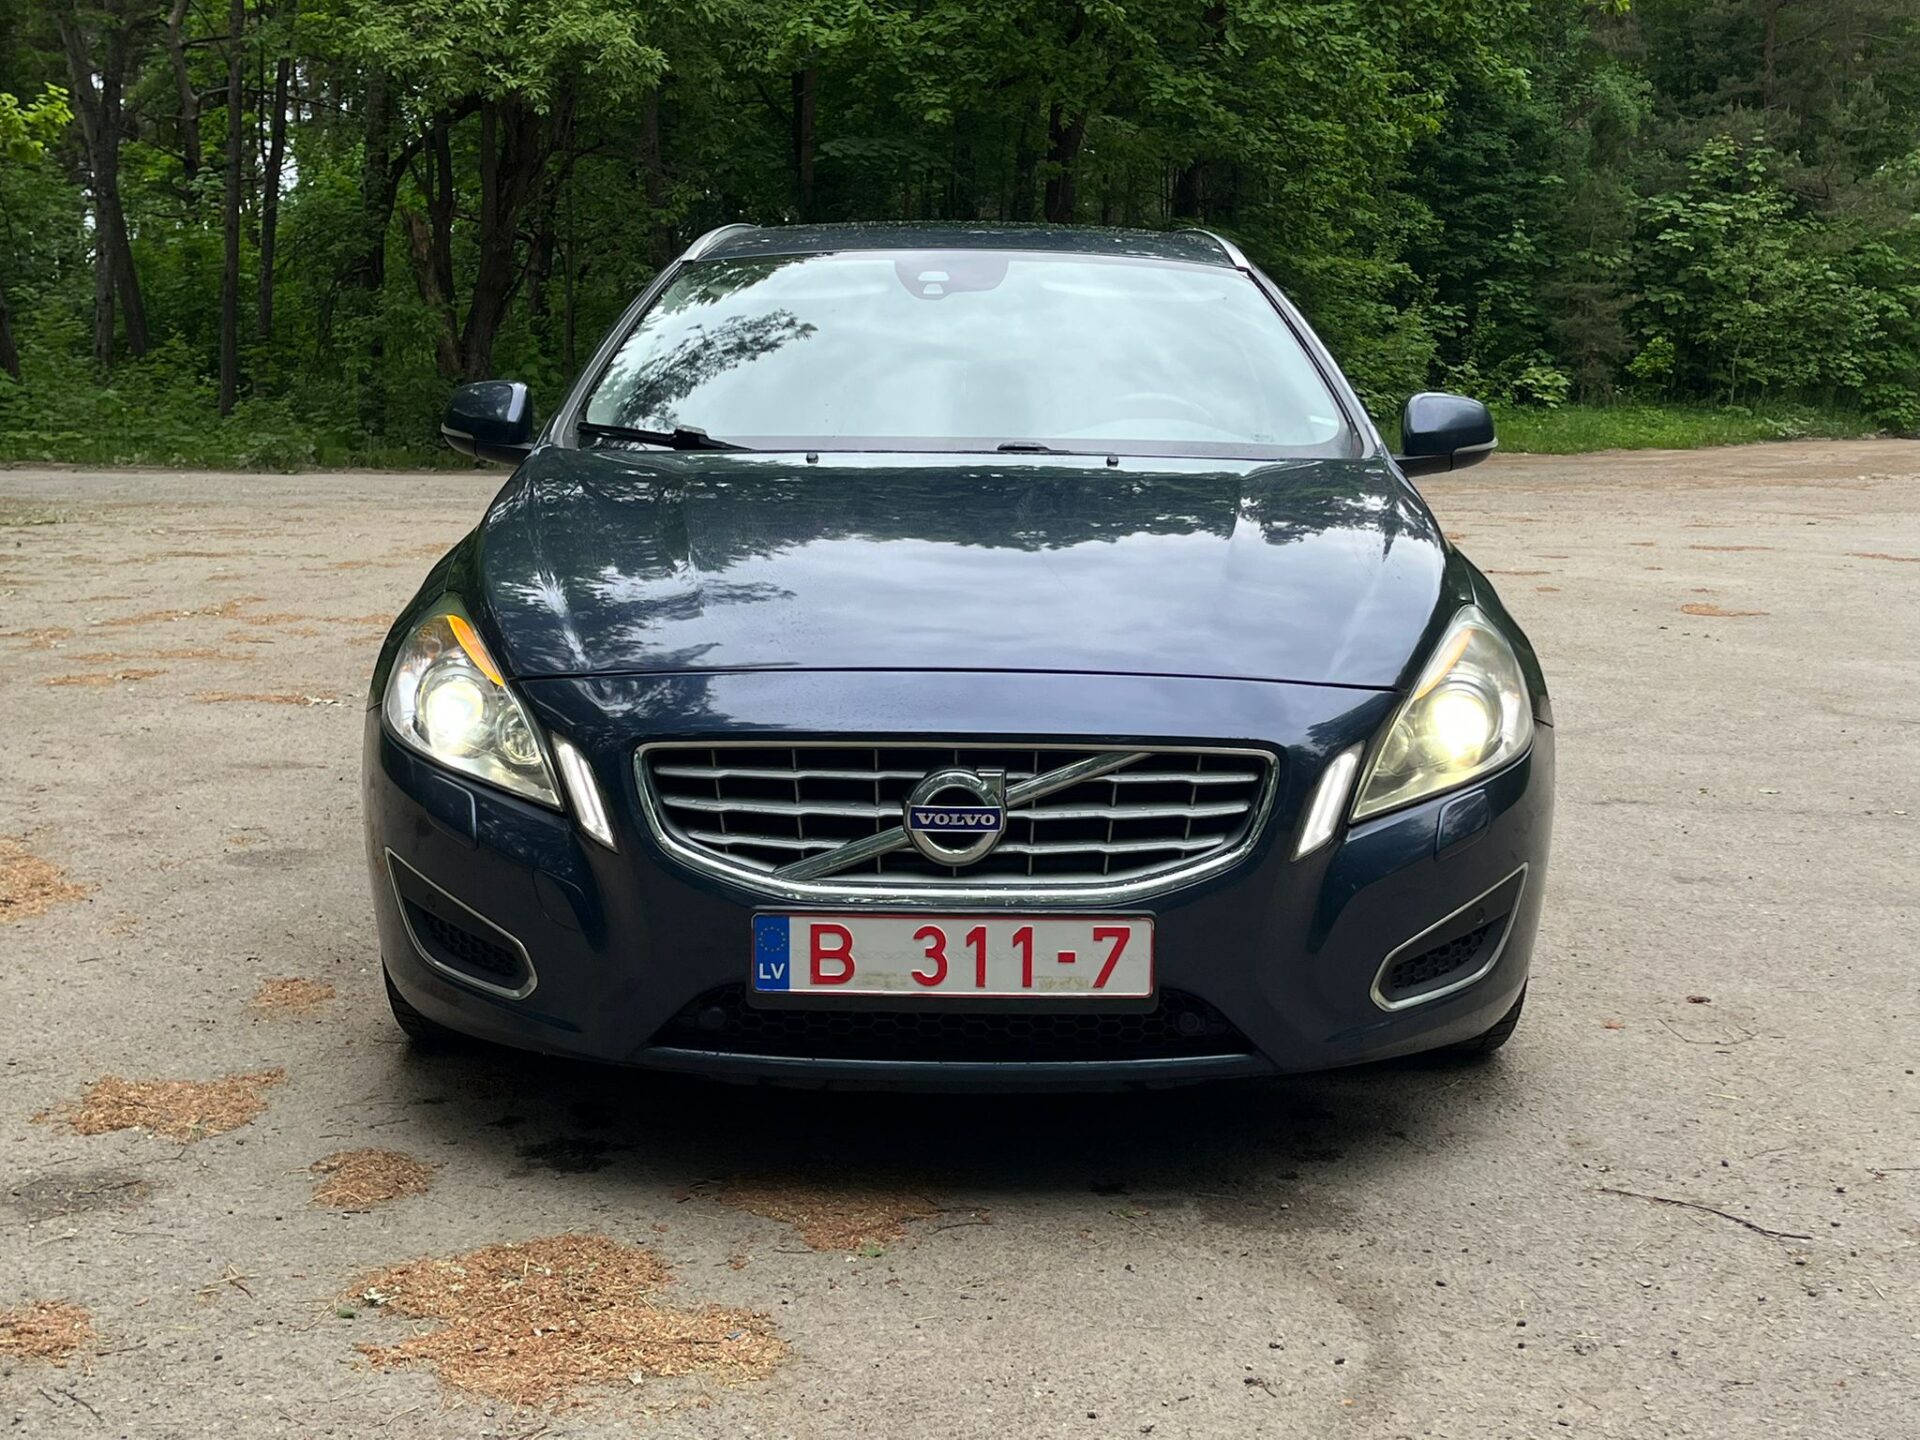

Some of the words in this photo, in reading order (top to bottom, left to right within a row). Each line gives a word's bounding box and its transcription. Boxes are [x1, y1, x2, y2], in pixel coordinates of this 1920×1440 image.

[915, 812, 996, 826] VOLVO
[809, 923, 856, 985] B
[910, 924, 1131, 989] 311-7
[758, 963, 785, 980] LV
